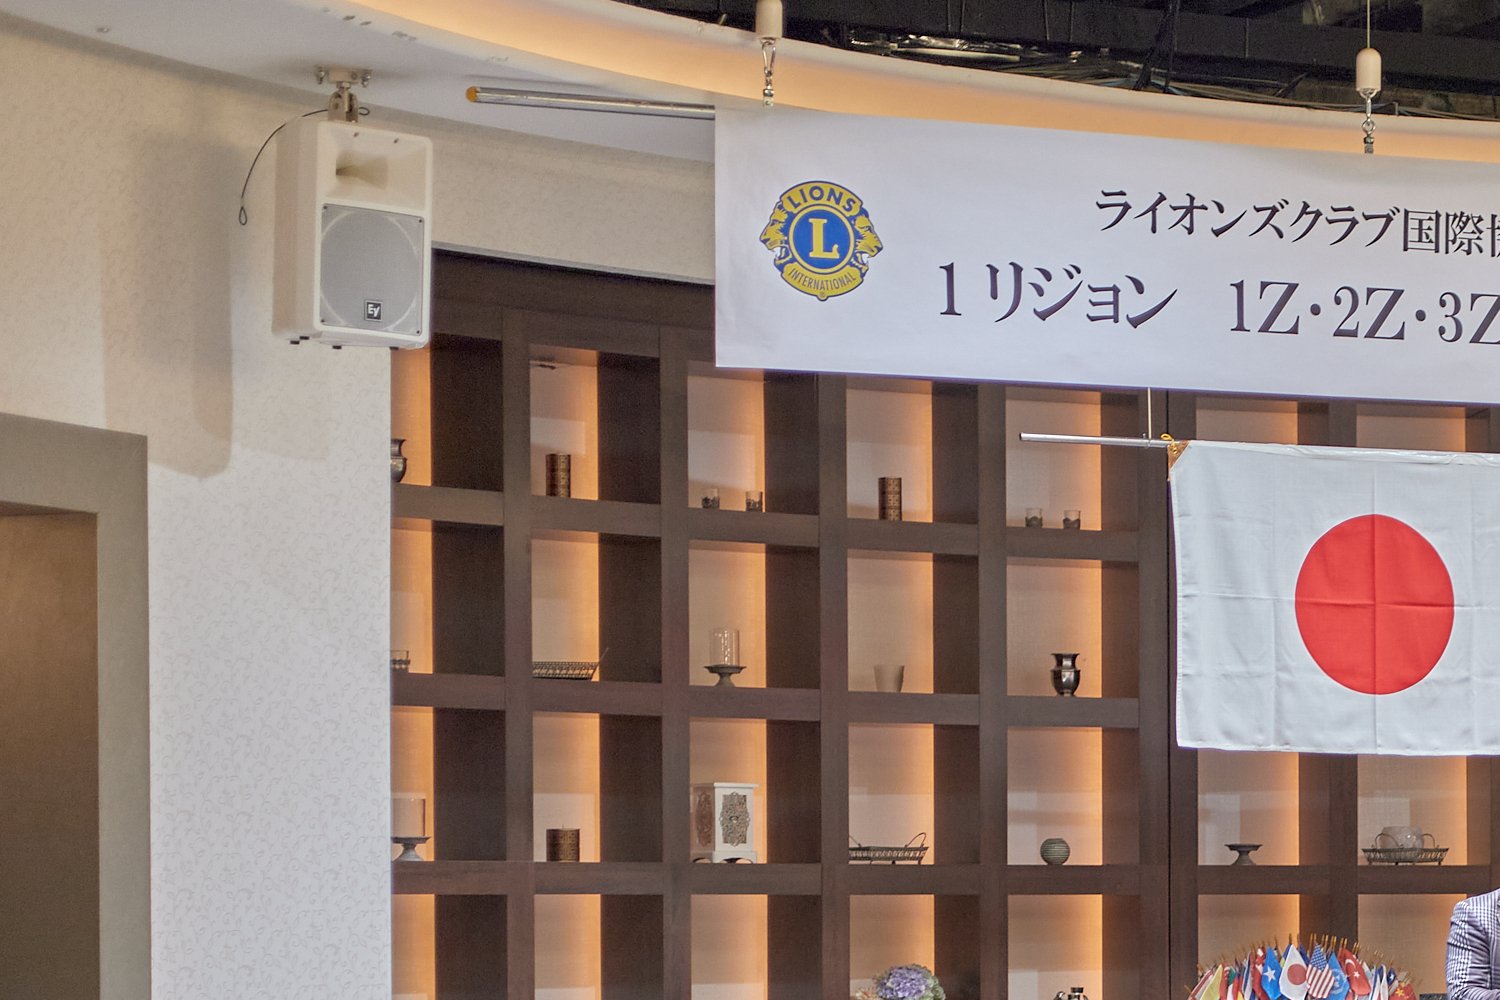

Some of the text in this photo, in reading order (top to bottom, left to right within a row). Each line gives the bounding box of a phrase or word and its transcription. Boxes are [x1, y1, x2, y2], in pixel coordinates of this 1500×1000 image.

[786, 185, 856, 212] LIONS
[808, 217, 840, 259] L
[788, 267, 857, 291] INTERNATIONAL
